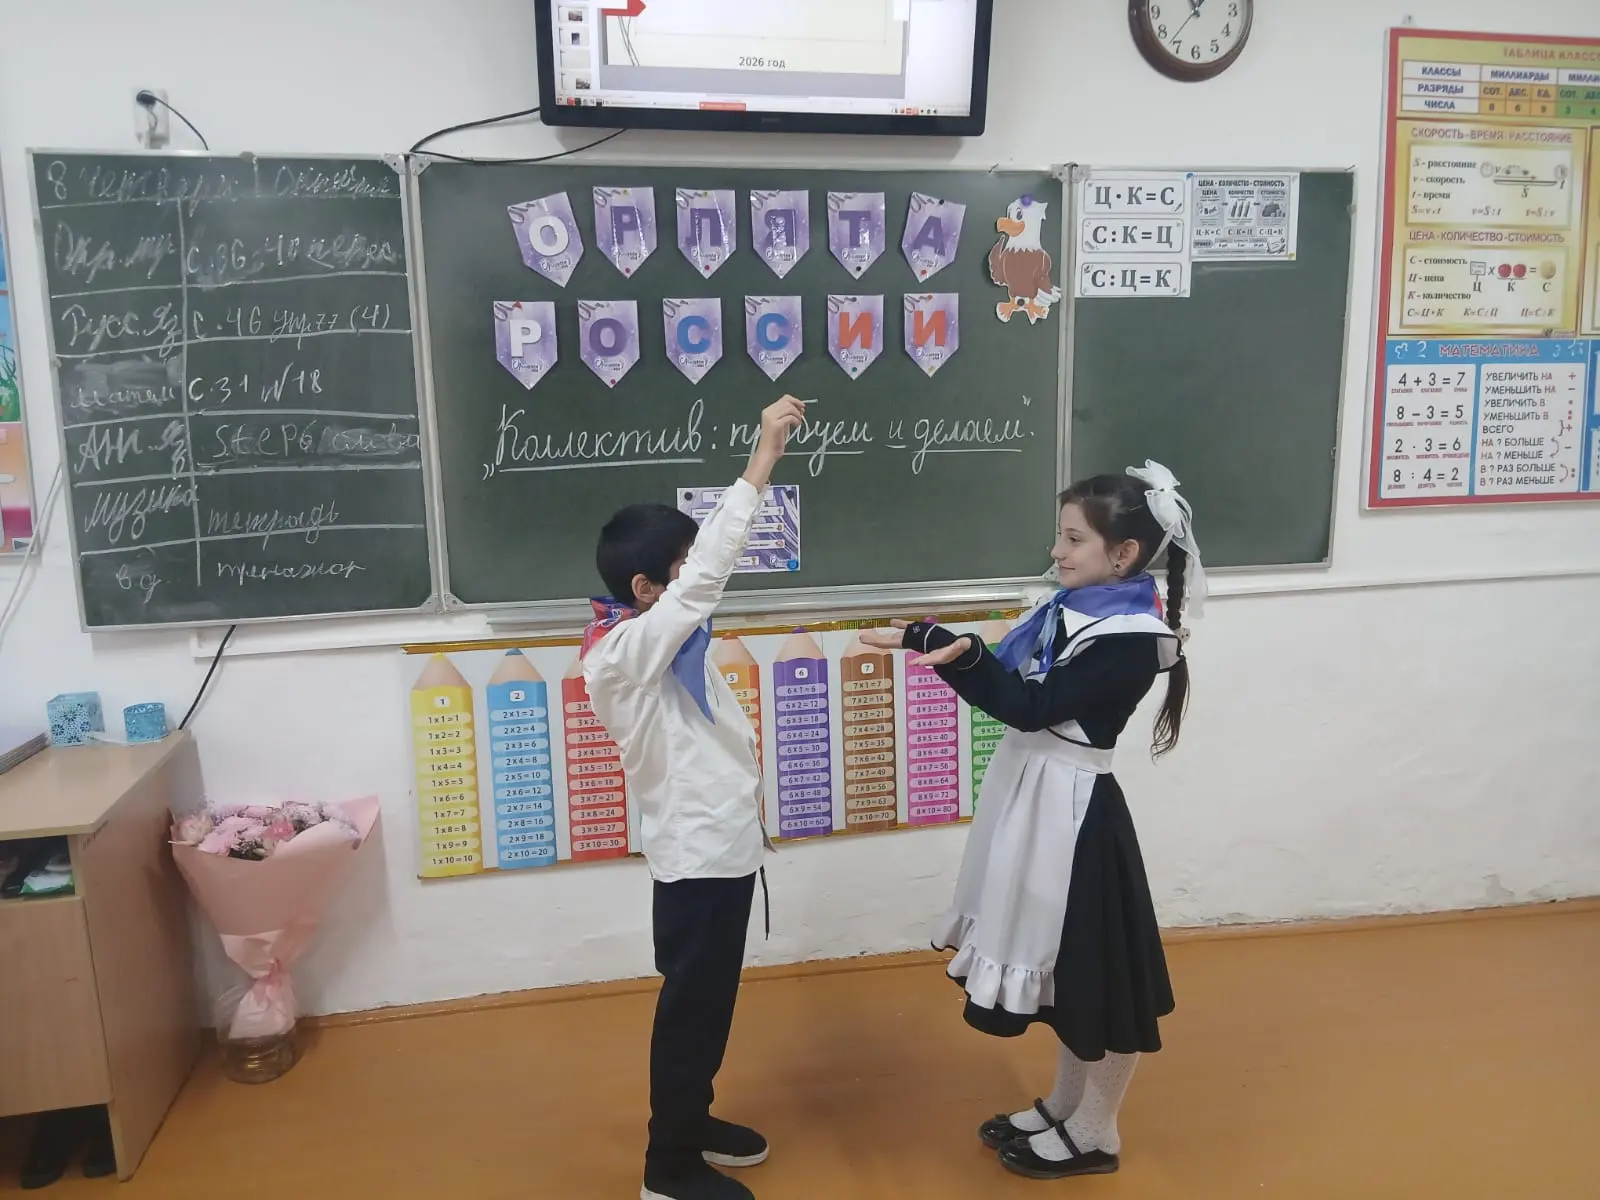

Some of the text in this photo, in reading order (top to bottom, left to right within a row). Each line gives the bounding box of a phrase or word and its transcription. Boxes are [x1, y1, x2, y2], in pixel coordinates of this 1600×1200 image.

[1151, 5, 1160, 20] 9
[1228, 3, 1238, 18] 3
[1158, 24, 1168, 39] 8
[1221, 22, 1231, 37] 4
[1172, 40, 1182, 54] 7
[1210, 39, 1219, 54] 5
[1191, 45, 1201, 60] 6
[739, 56, 786, 69] 2026 год
[1421, 66, 1461, 77] КЛАССЫ
[1491, 70, 1550, 81] МИЛЛИАРДЫ
[1418, 83, 1464, 94] РАЗРЯДЫ
[1424, 100, 1455, 109] ЧИСЛА
[1439, 344, 1539, 357] МАТЕМАТИКА
[1486, 372, 1553, 381] УВЕЛИЧИТЬ НА
[1484, 385, 1556, 394] УМЕНЬШИТЬ НА
[1484, 399, 1537, 408] УВЕЛИЧИТЬ
[1483, 412, 1540, 421] УМЕНЬШИТЬ
[1482, 425, 1514, 434] ВСЕГО
[729, 415, 873, 477] прбуем
[888, 419, 904, 440] и
[1504, 437, 1544, 446] БОЛЬШЕ
[1480, 452, 1493, 460] НА
[1504, 450, 1543, 459] МЕНЬШЕ
[1497, 464, 1514, 472] РАЗ
[1516, 463, 1556, 472] БОЛЬШЕ
[1496, 477, 1513, 485] РАЗ
[1515, 476, 1555, 485] МЕНЬШЕ
